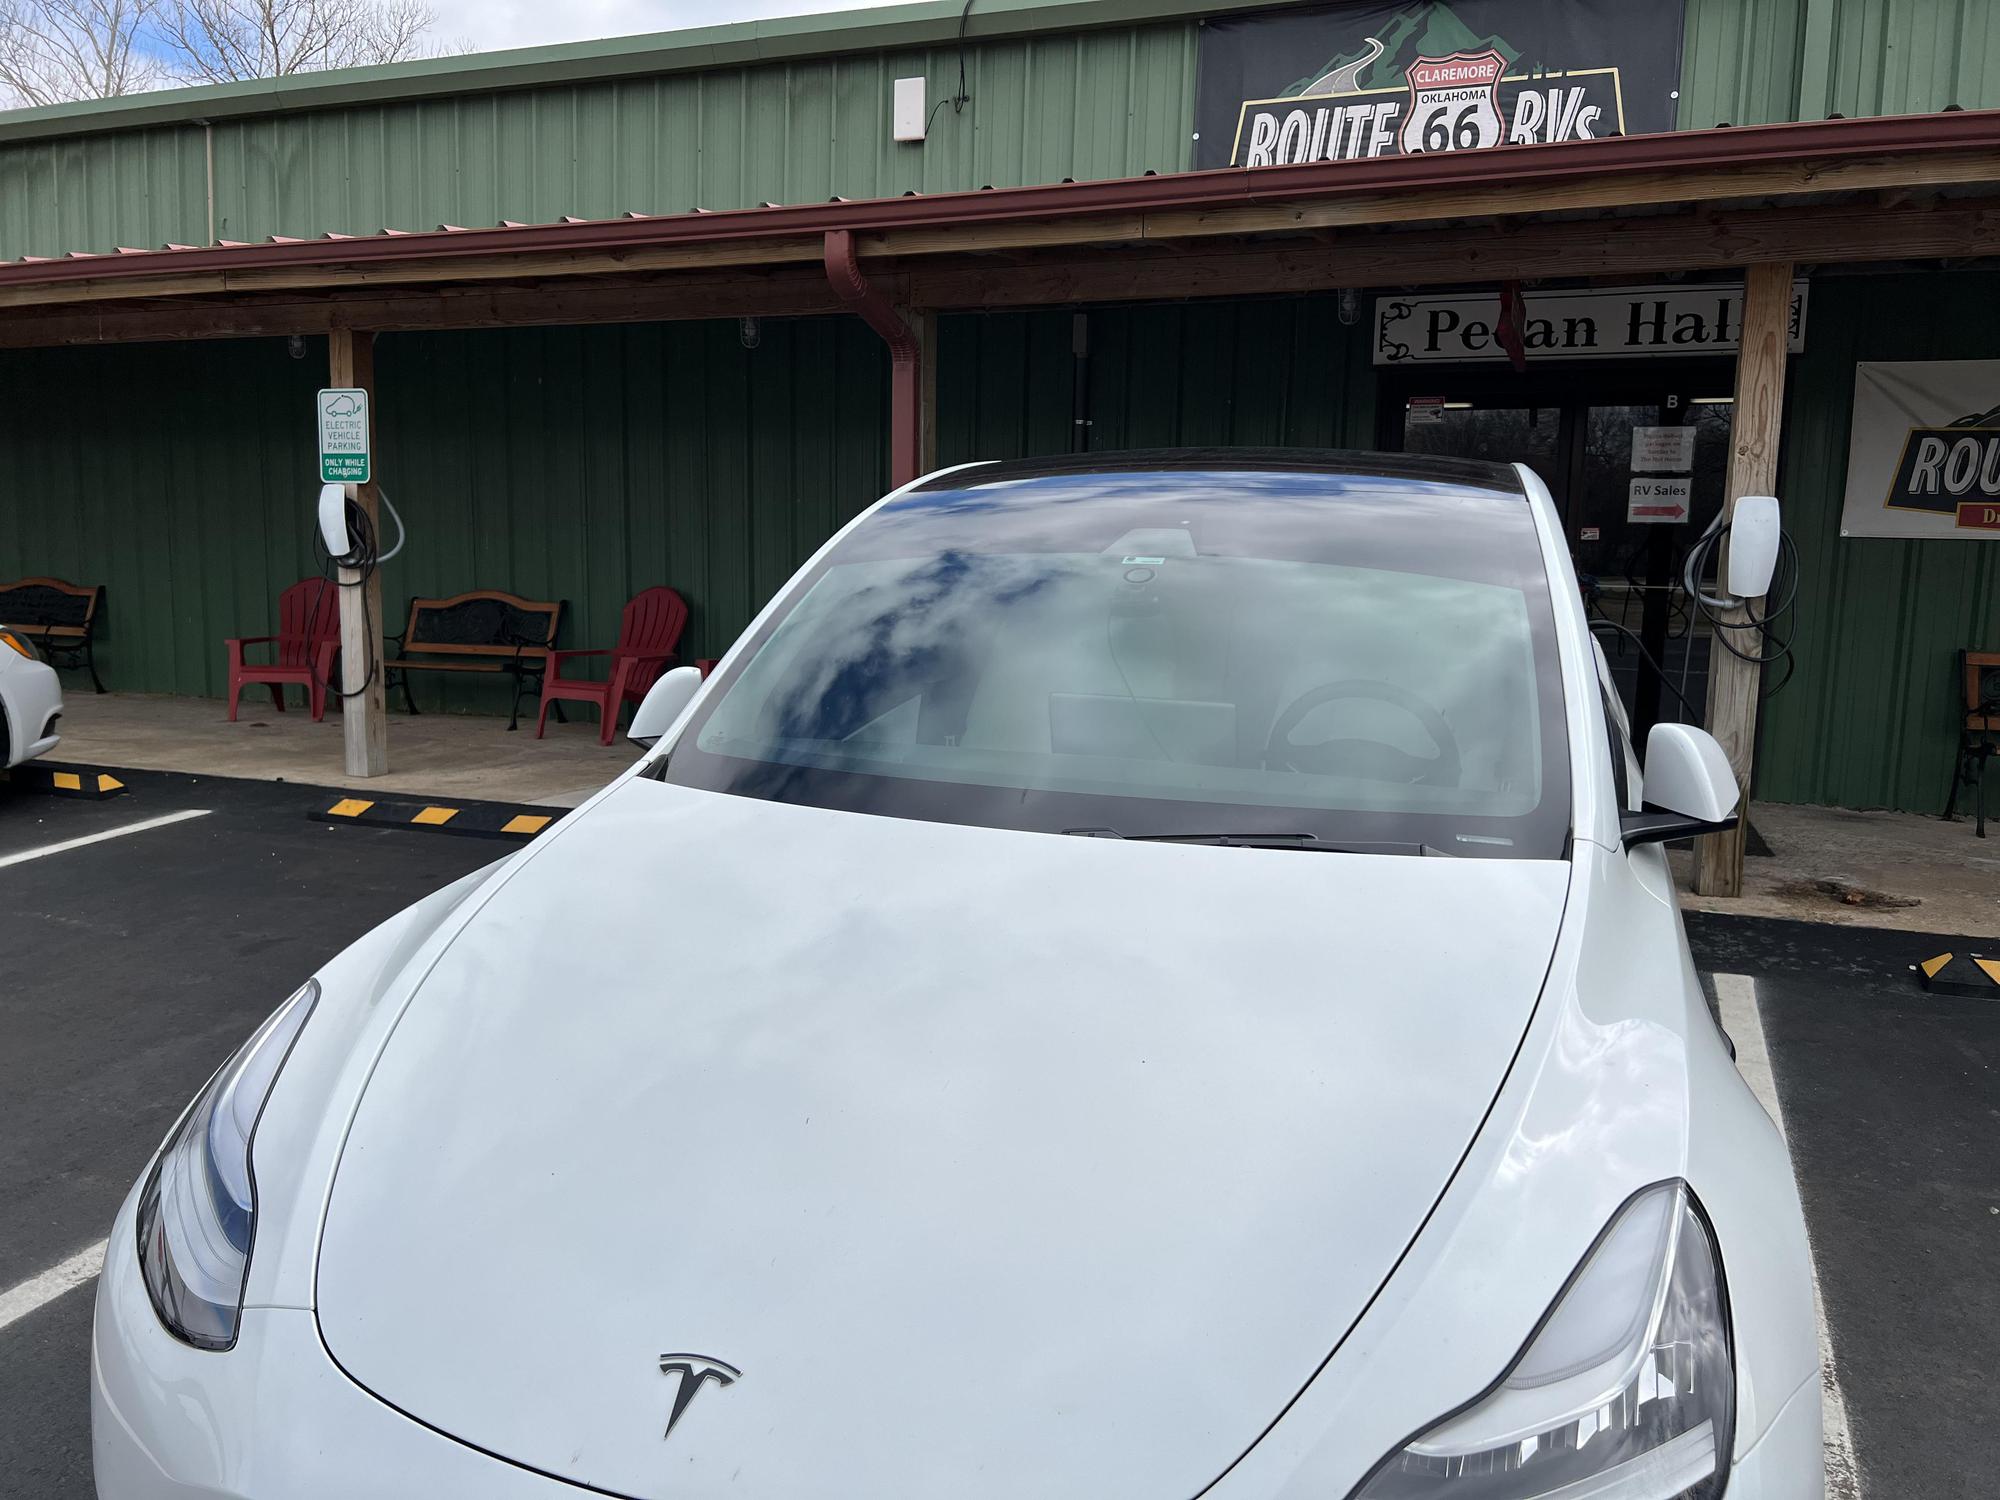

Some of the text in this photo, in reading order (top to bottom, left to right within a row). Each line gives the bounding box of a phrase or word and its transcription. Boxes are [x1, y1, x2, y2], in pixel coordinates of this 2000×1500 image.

[1416, 64, 1495, 83] CLAREMORE
[1421, 89, 1487, 104] OKLAHOMA
[1246, 86, 1602, 168] ROUTE 66 RVs
[1424, 299, 1743, 352] Pean Hal
[1667, 394, 1678, 408] B
[325, 420, 362, 430] ELECTRIC
[328, 431, 360, 440] VEHICLE
[327, 441, 361, 451] PARKING
[325, 458, 365, 466] ONLY WHILE
[328, 467, 362, 476] CHARGING
[1633, 485, 1686, 496] RV Sales
[1983, 508, 2000, 524] D
